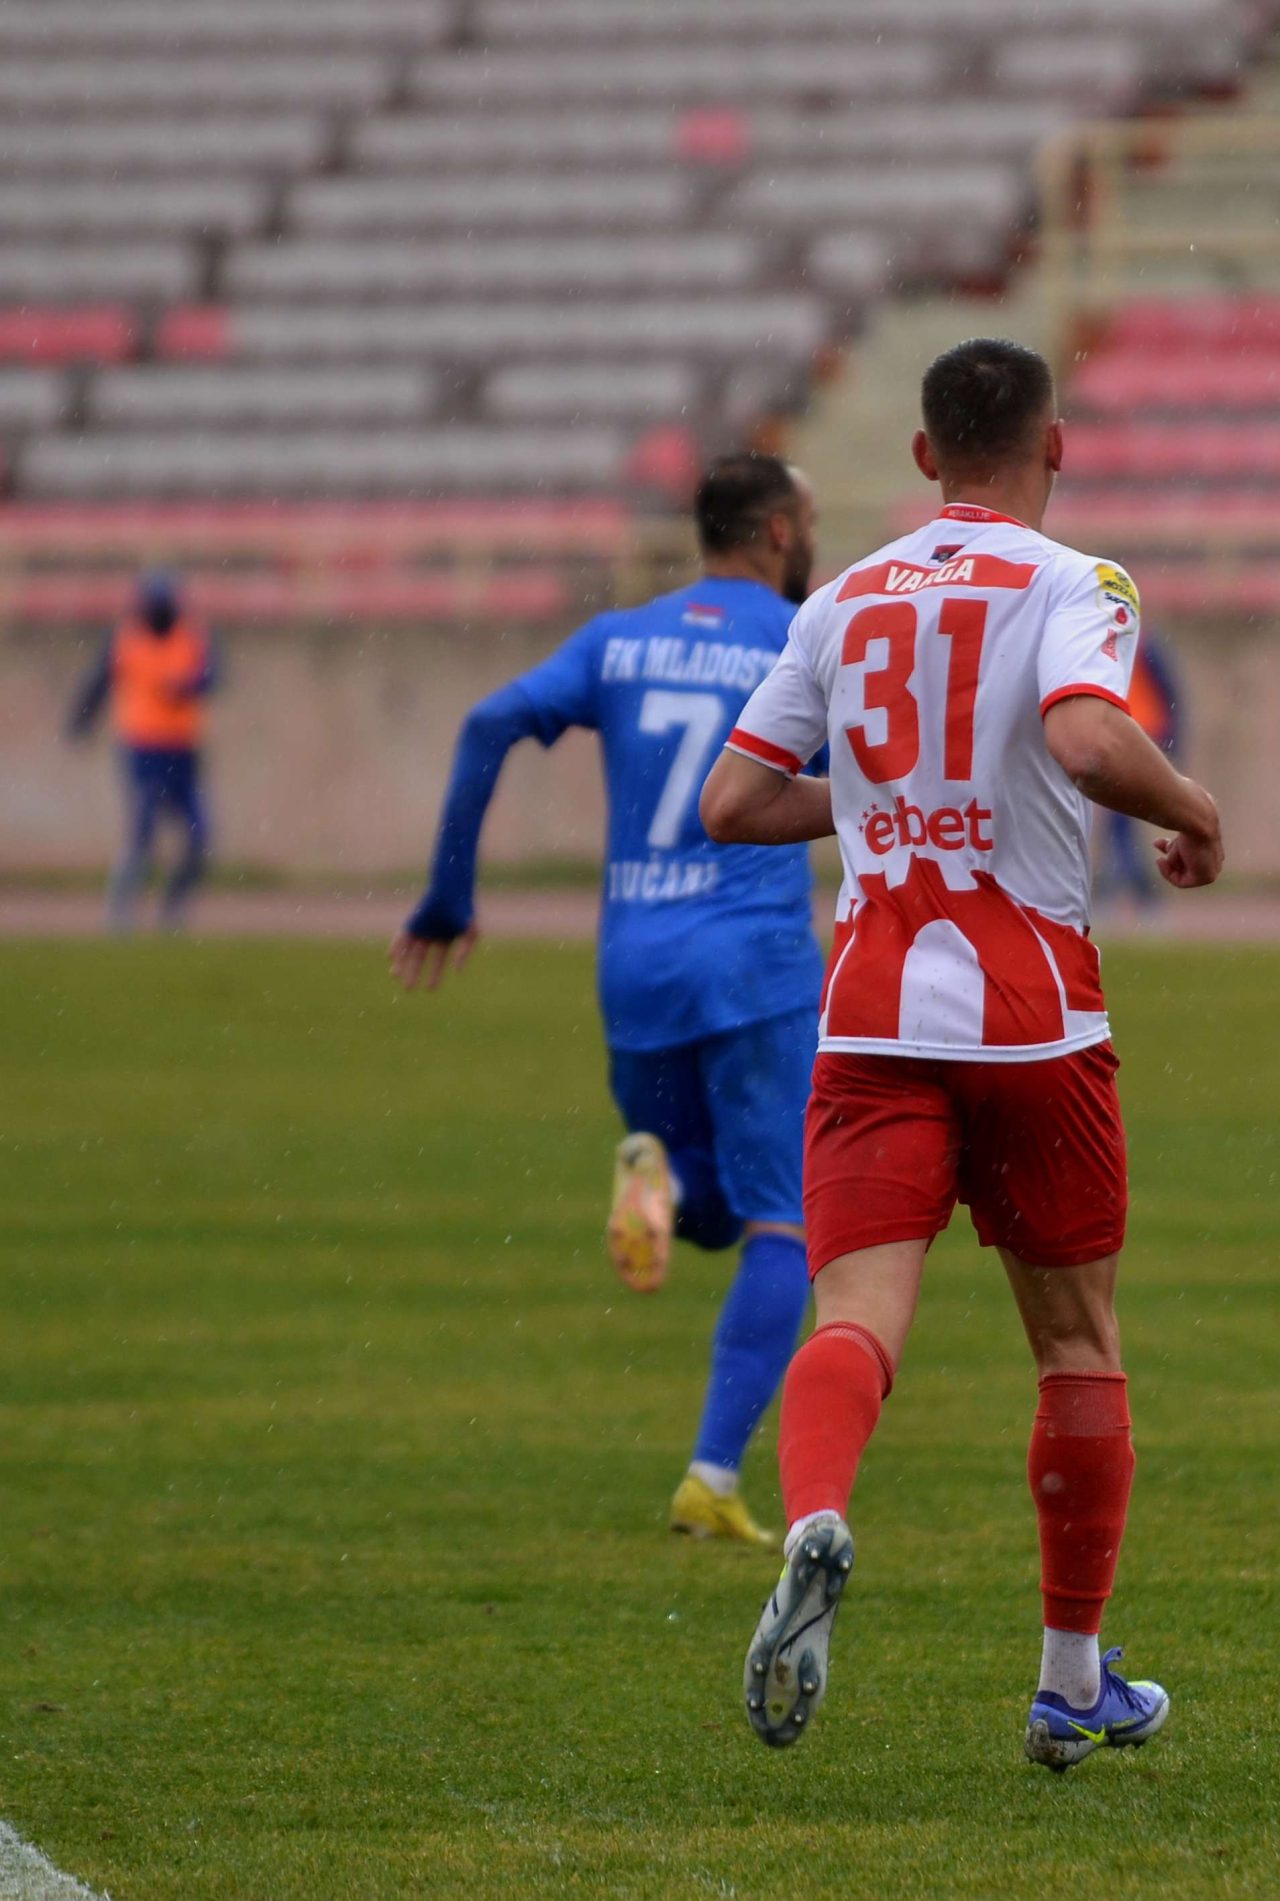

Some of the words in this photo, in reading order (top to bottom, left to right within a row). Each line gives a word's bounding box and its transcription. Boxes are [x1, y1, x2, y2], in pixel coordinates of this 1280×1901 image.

[601, 637, 643, 683] FK
[841, 598, 988, 784] 31
[638, 689, 725, 850] 7
